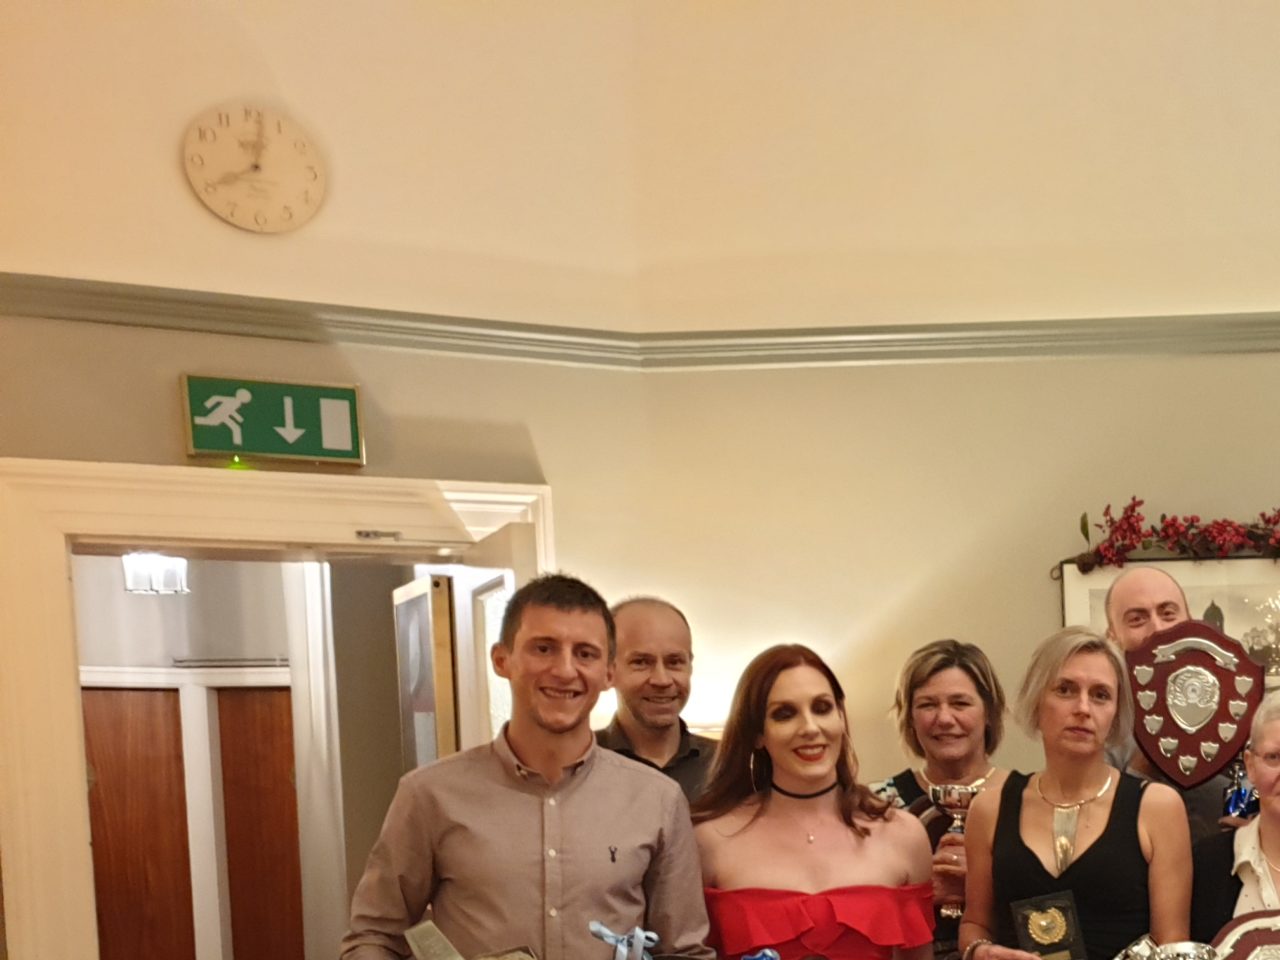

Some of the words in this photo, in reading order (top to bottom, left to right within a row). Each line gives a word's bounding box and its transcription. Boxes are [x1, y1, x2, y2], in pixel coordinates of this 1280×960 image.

[217, 112, 231, 128] 11
[275, 120, 283, 135] 1
[198, 126, 217, 144] 10
